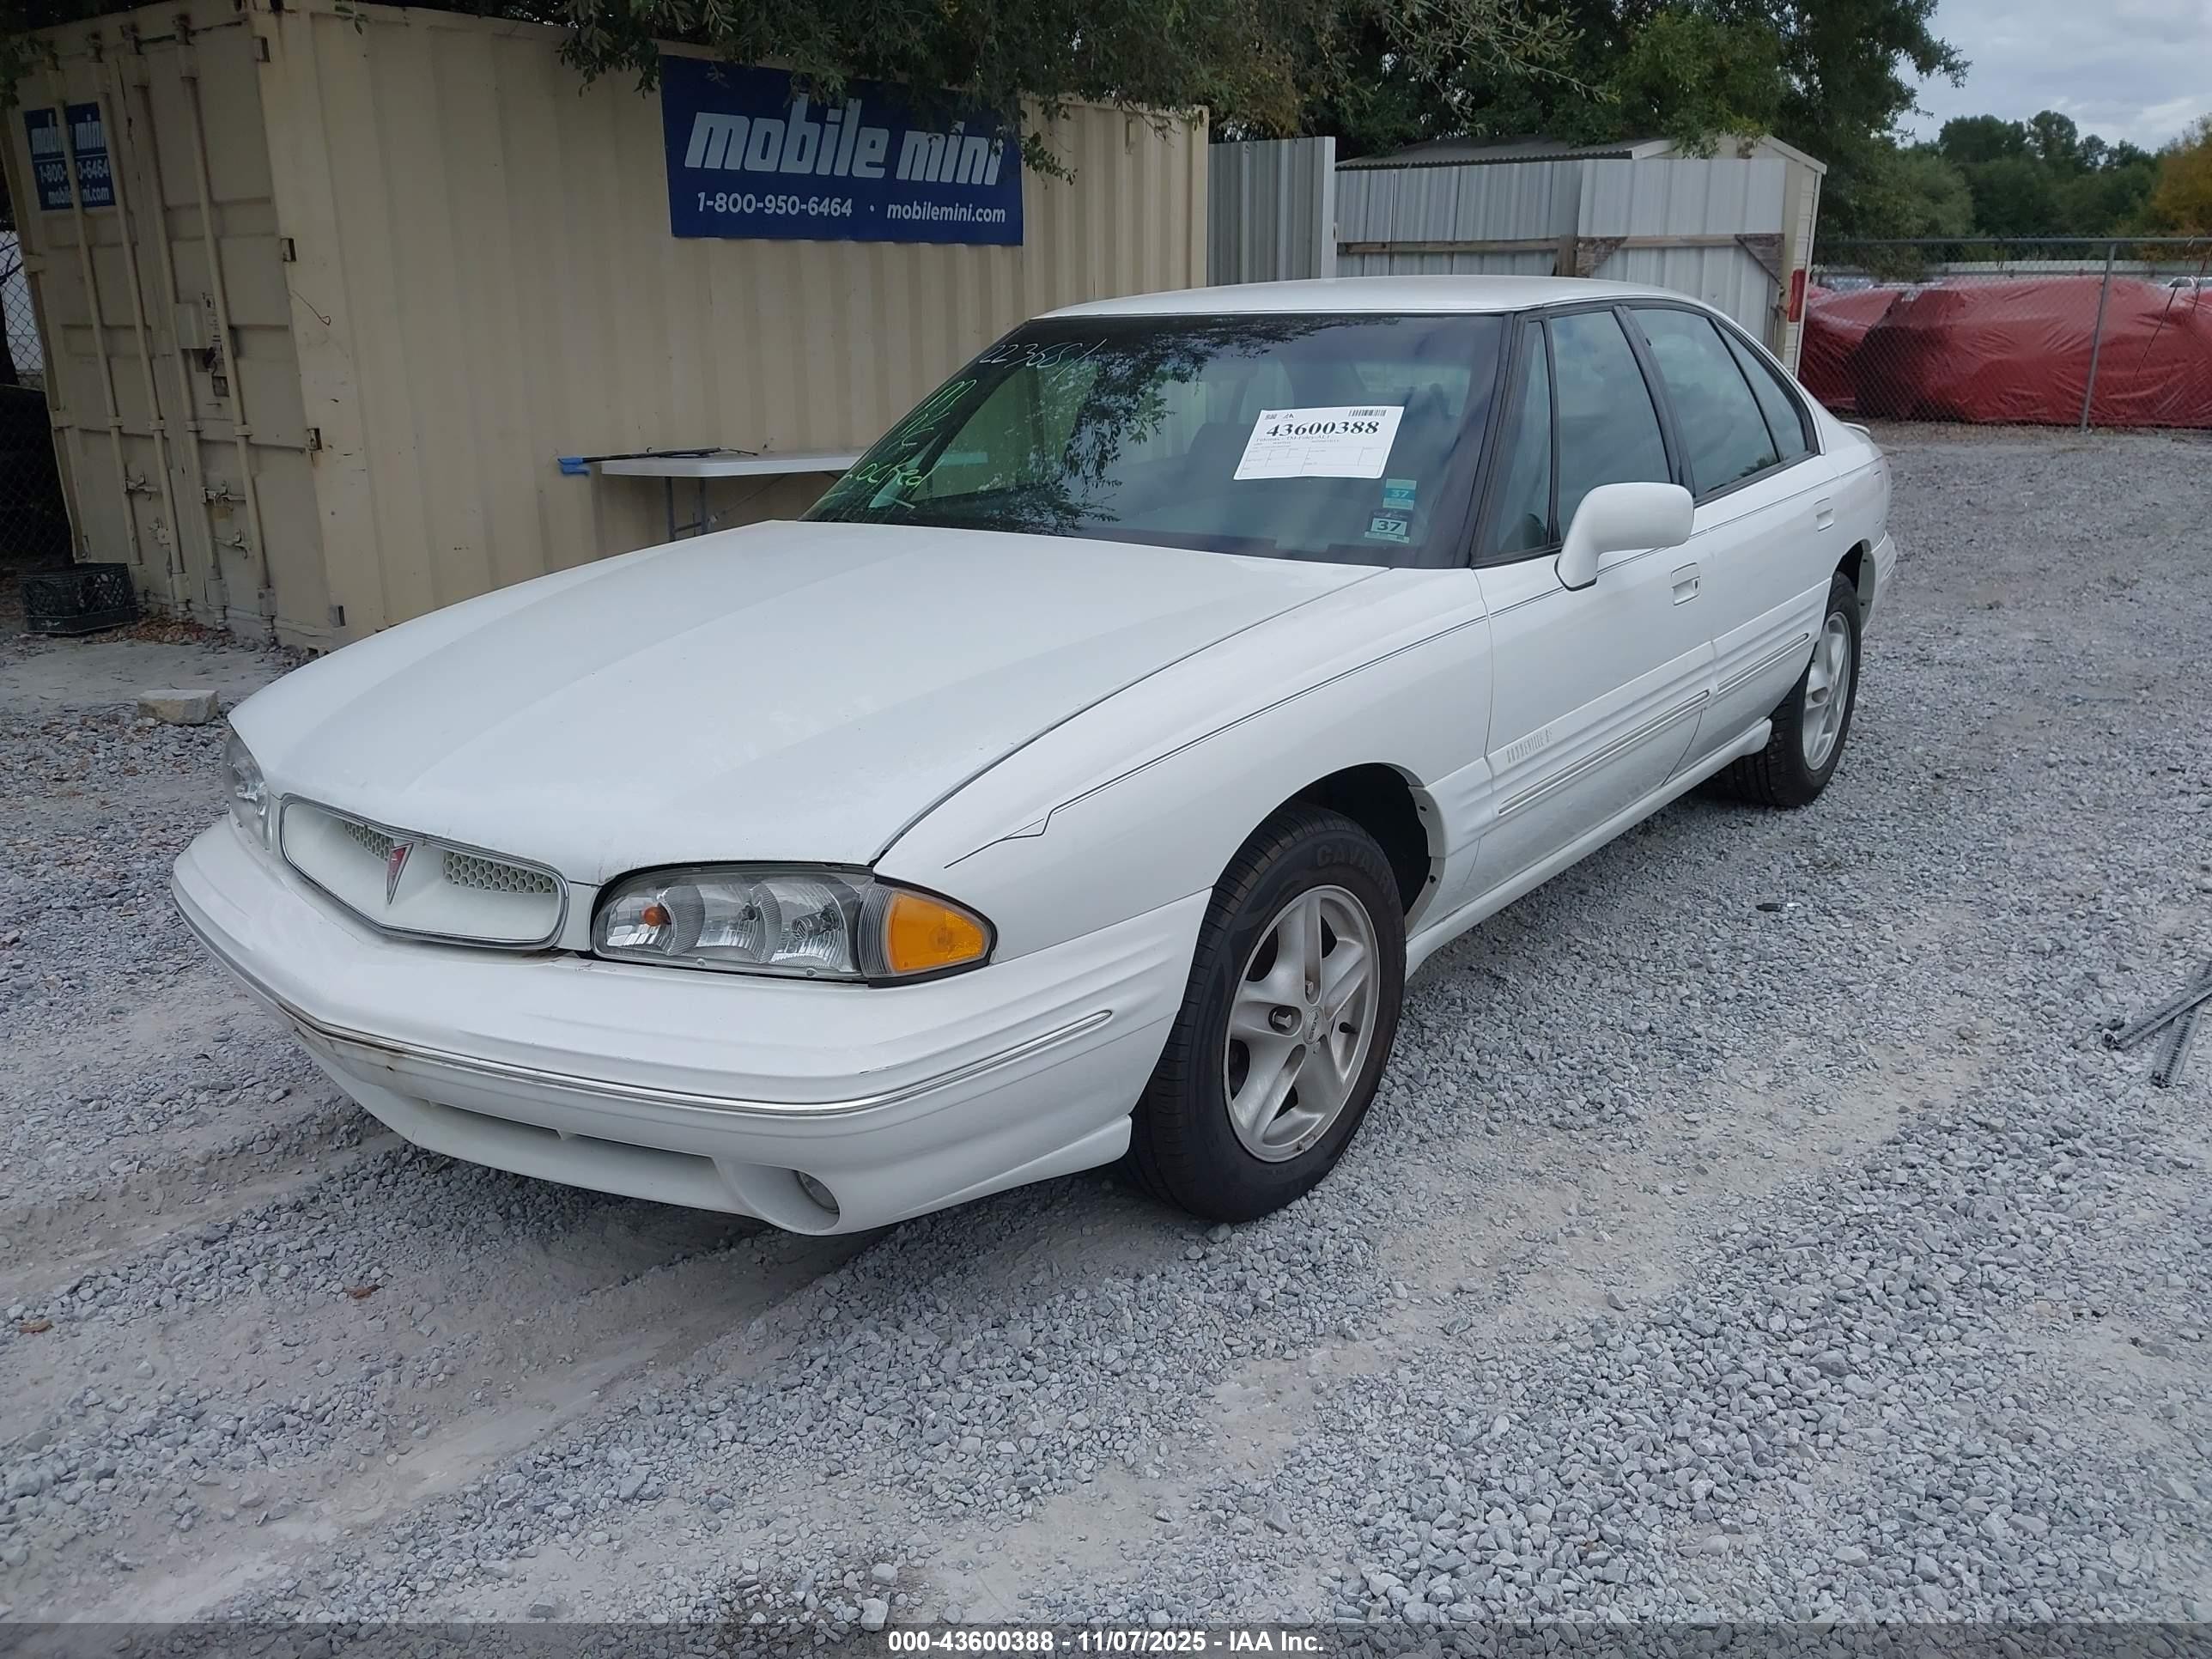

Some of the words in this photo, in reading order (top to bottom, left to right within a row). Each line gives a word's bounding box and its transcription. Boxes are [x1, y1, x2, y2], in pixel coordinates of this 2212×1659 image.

[684, 92, 890, 178] mobile
[896, 119, 1006, 185] mini
[697, 191, 853, 217] 1-800-950-6464
[886, 200, 1006, 223] mobilemini.com
[1265, 421, 1380, 437] 43600388
[1377, 520, 1402, 532] 37
